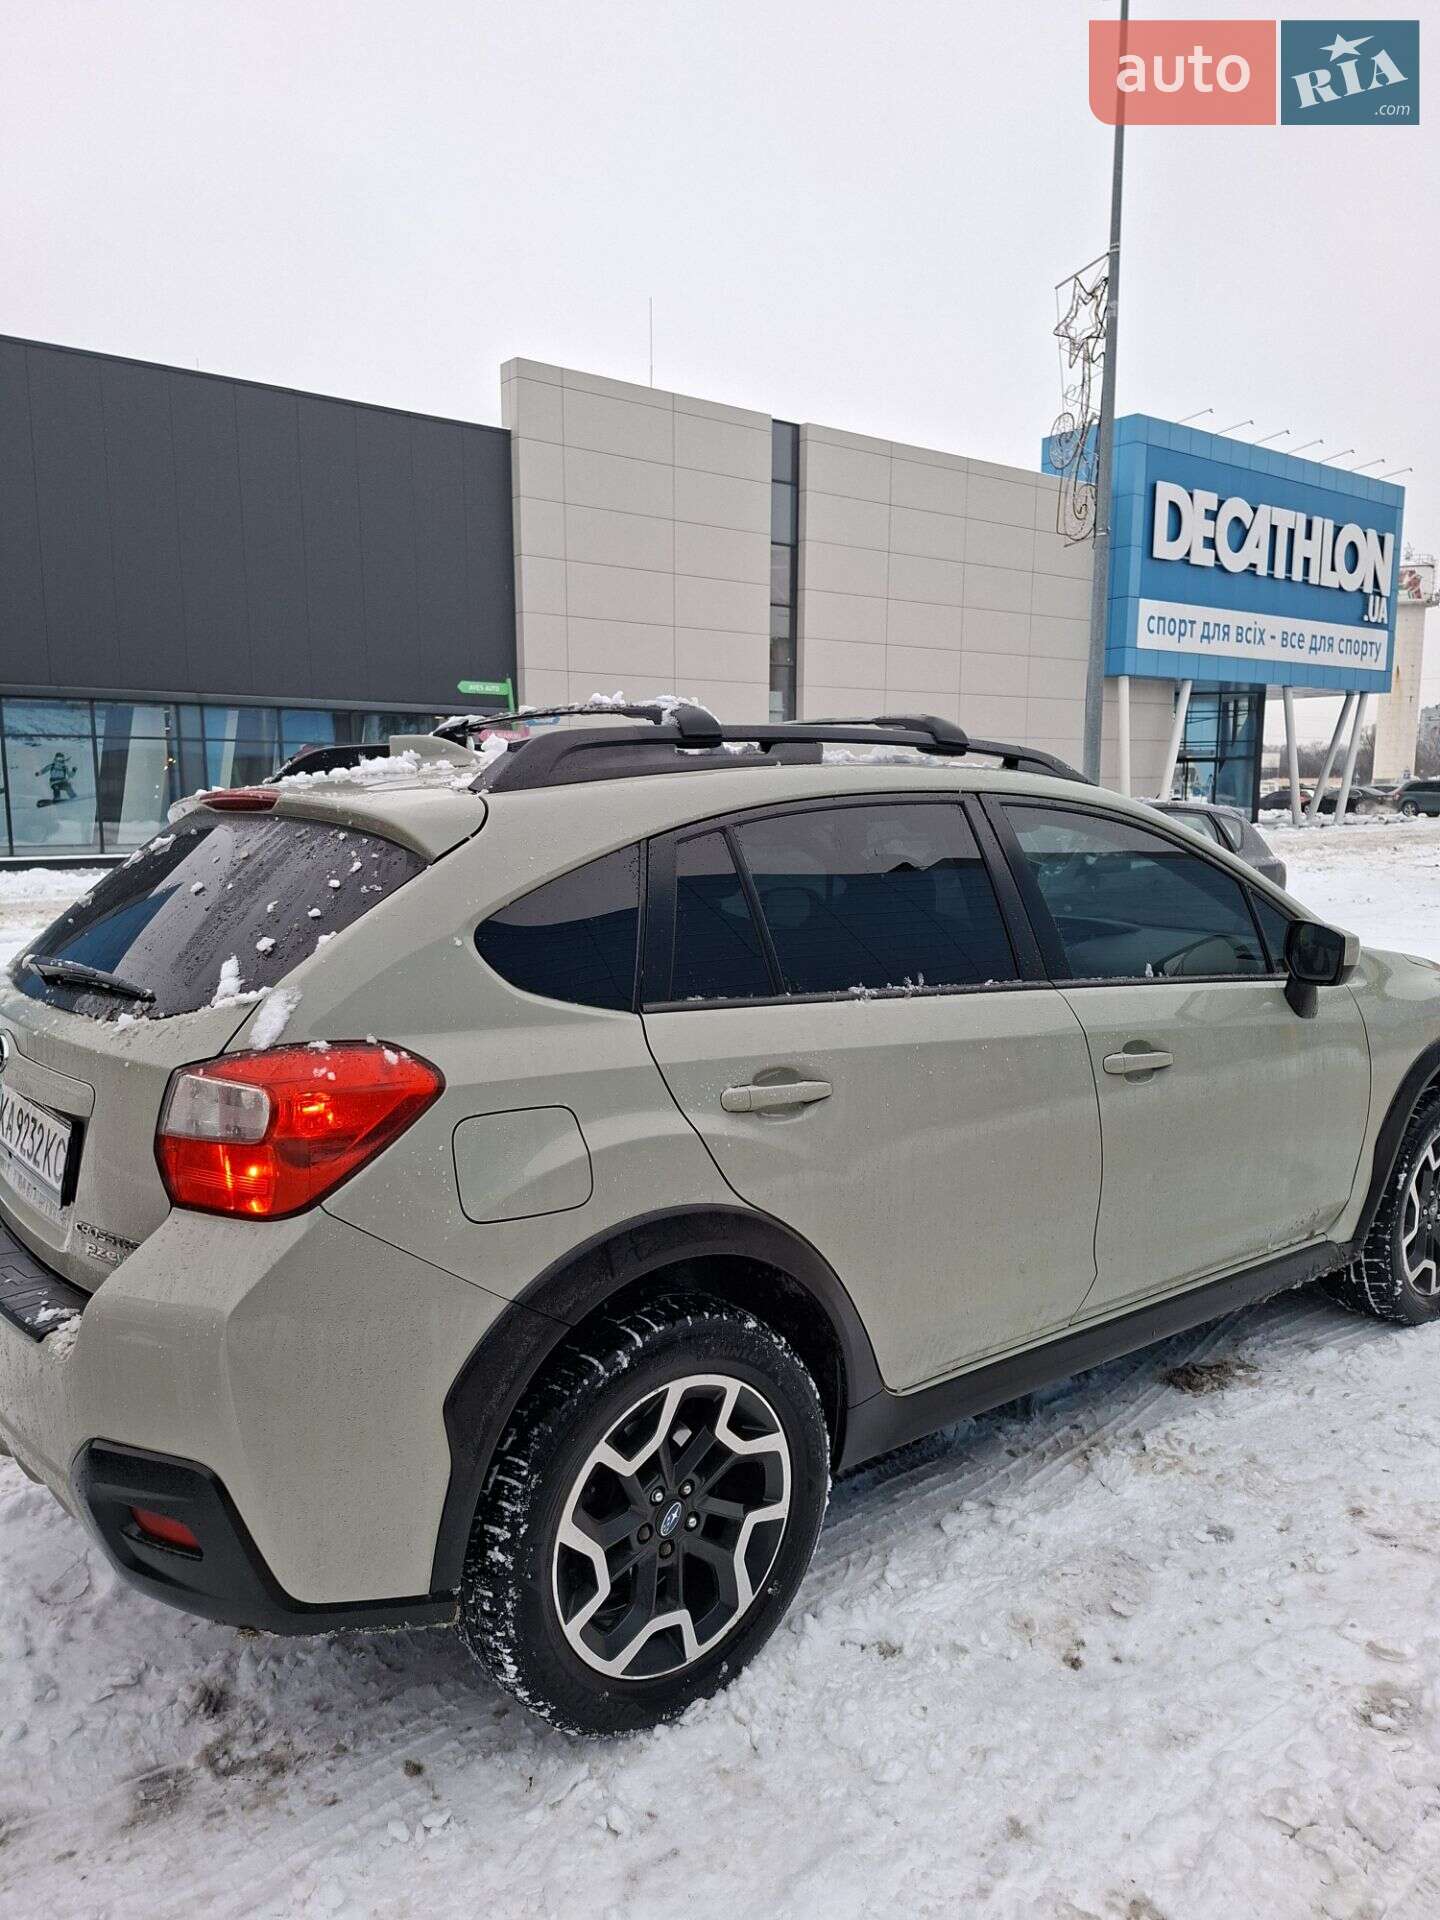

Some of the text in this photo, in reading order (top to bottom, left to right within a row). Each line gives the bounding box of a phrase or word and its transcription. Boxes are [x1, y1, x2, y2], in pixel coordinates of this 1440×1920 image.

[1152, 480, 1395, 597] DECATHLON
[1363, 594, 1388, 625] .UA
[1147, 612, 1196, 645] спорт
[1201, 621, 1231, 645] для
[1236, 619, 1266, 646] всіх
[1281, 630, 1305, 650] все
[1309, 633, 1334, 655] для
[1338, 636, 1382, 663] спорту
